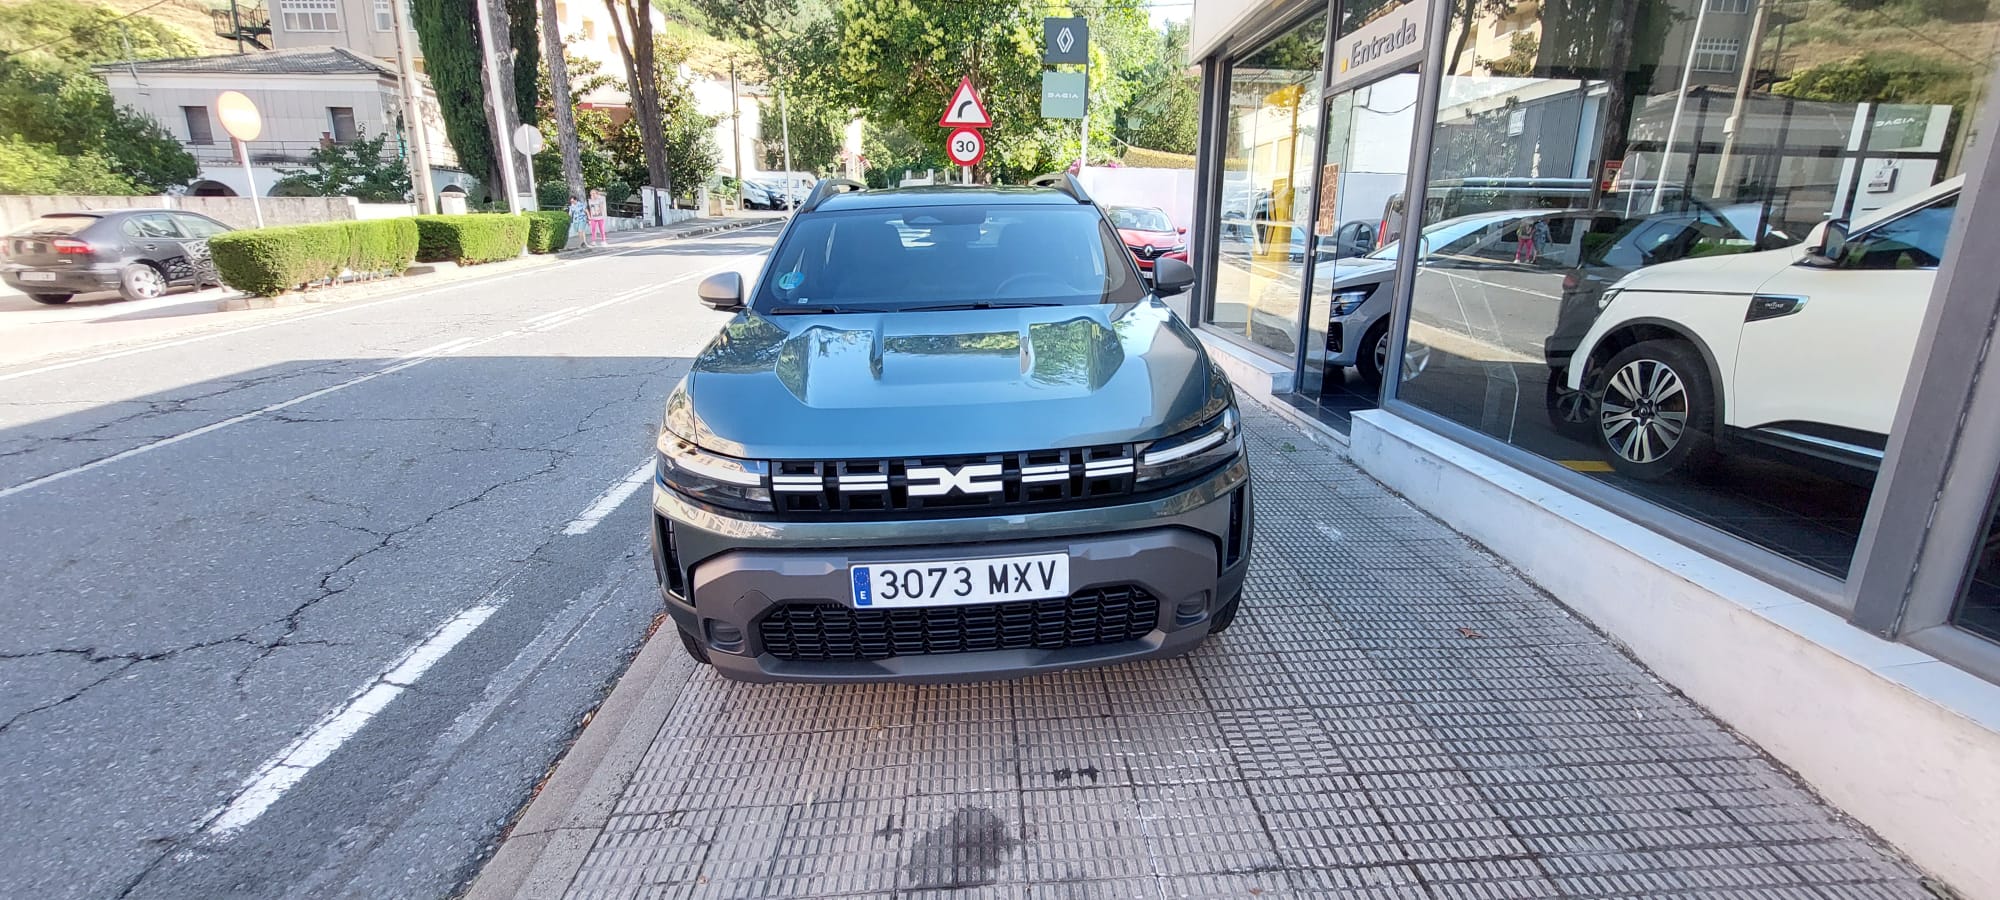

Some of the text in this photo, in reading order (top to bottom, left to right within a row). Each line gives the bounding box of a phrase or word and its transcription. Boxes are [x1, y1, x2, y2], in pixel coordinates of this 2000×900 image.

[1350, 17, 1417, 69] Entrada
[1875, 117, 1915, 128] DACIA
[955, 140, 976, 153] 30
[879, 560, 1056, 600] 3073 MXV
[860, 591, 867, 600] E
